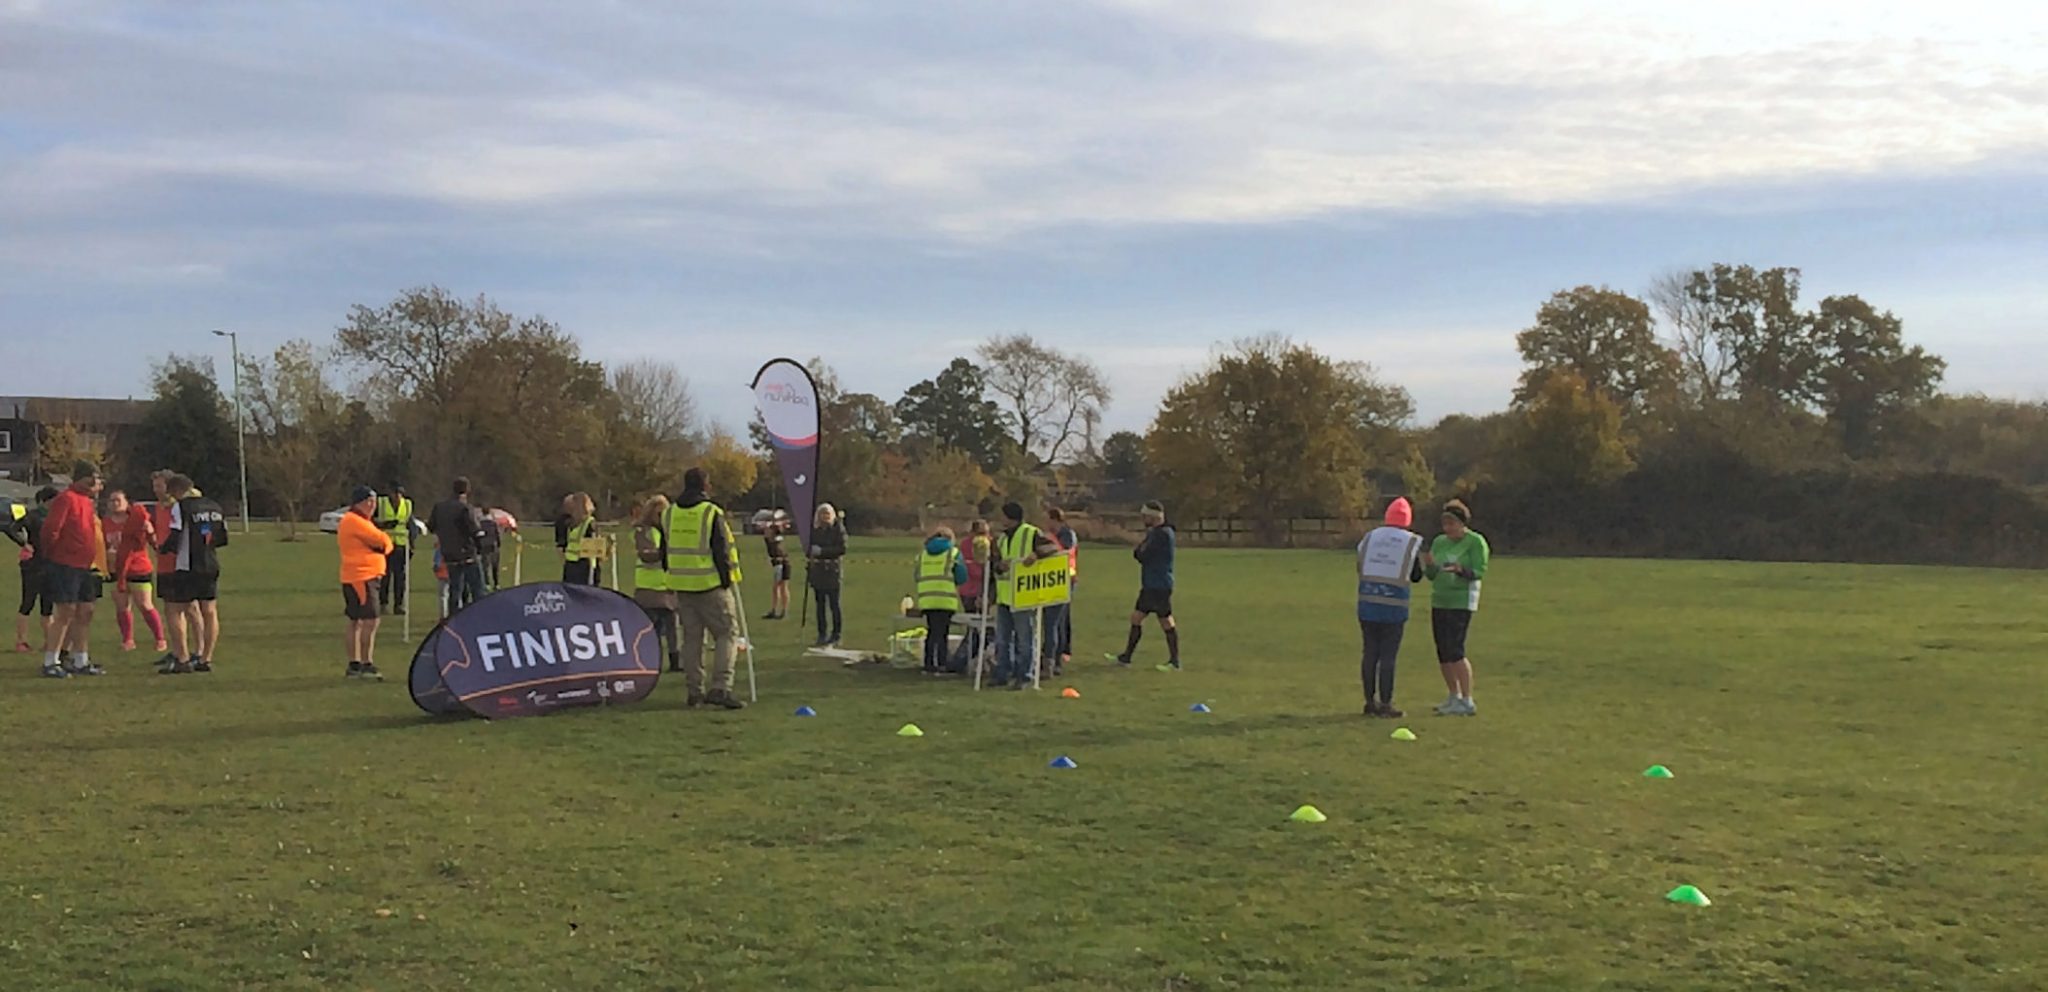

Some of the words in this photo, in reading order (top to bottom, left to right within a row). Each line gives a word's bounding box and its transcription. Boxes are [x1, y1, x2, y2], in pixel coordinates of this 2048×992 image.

[1017, 569, 1066, 592] FINISH
[524, 599, 566, 616] parkrun
[476, 620, 626, 672] FINISH
